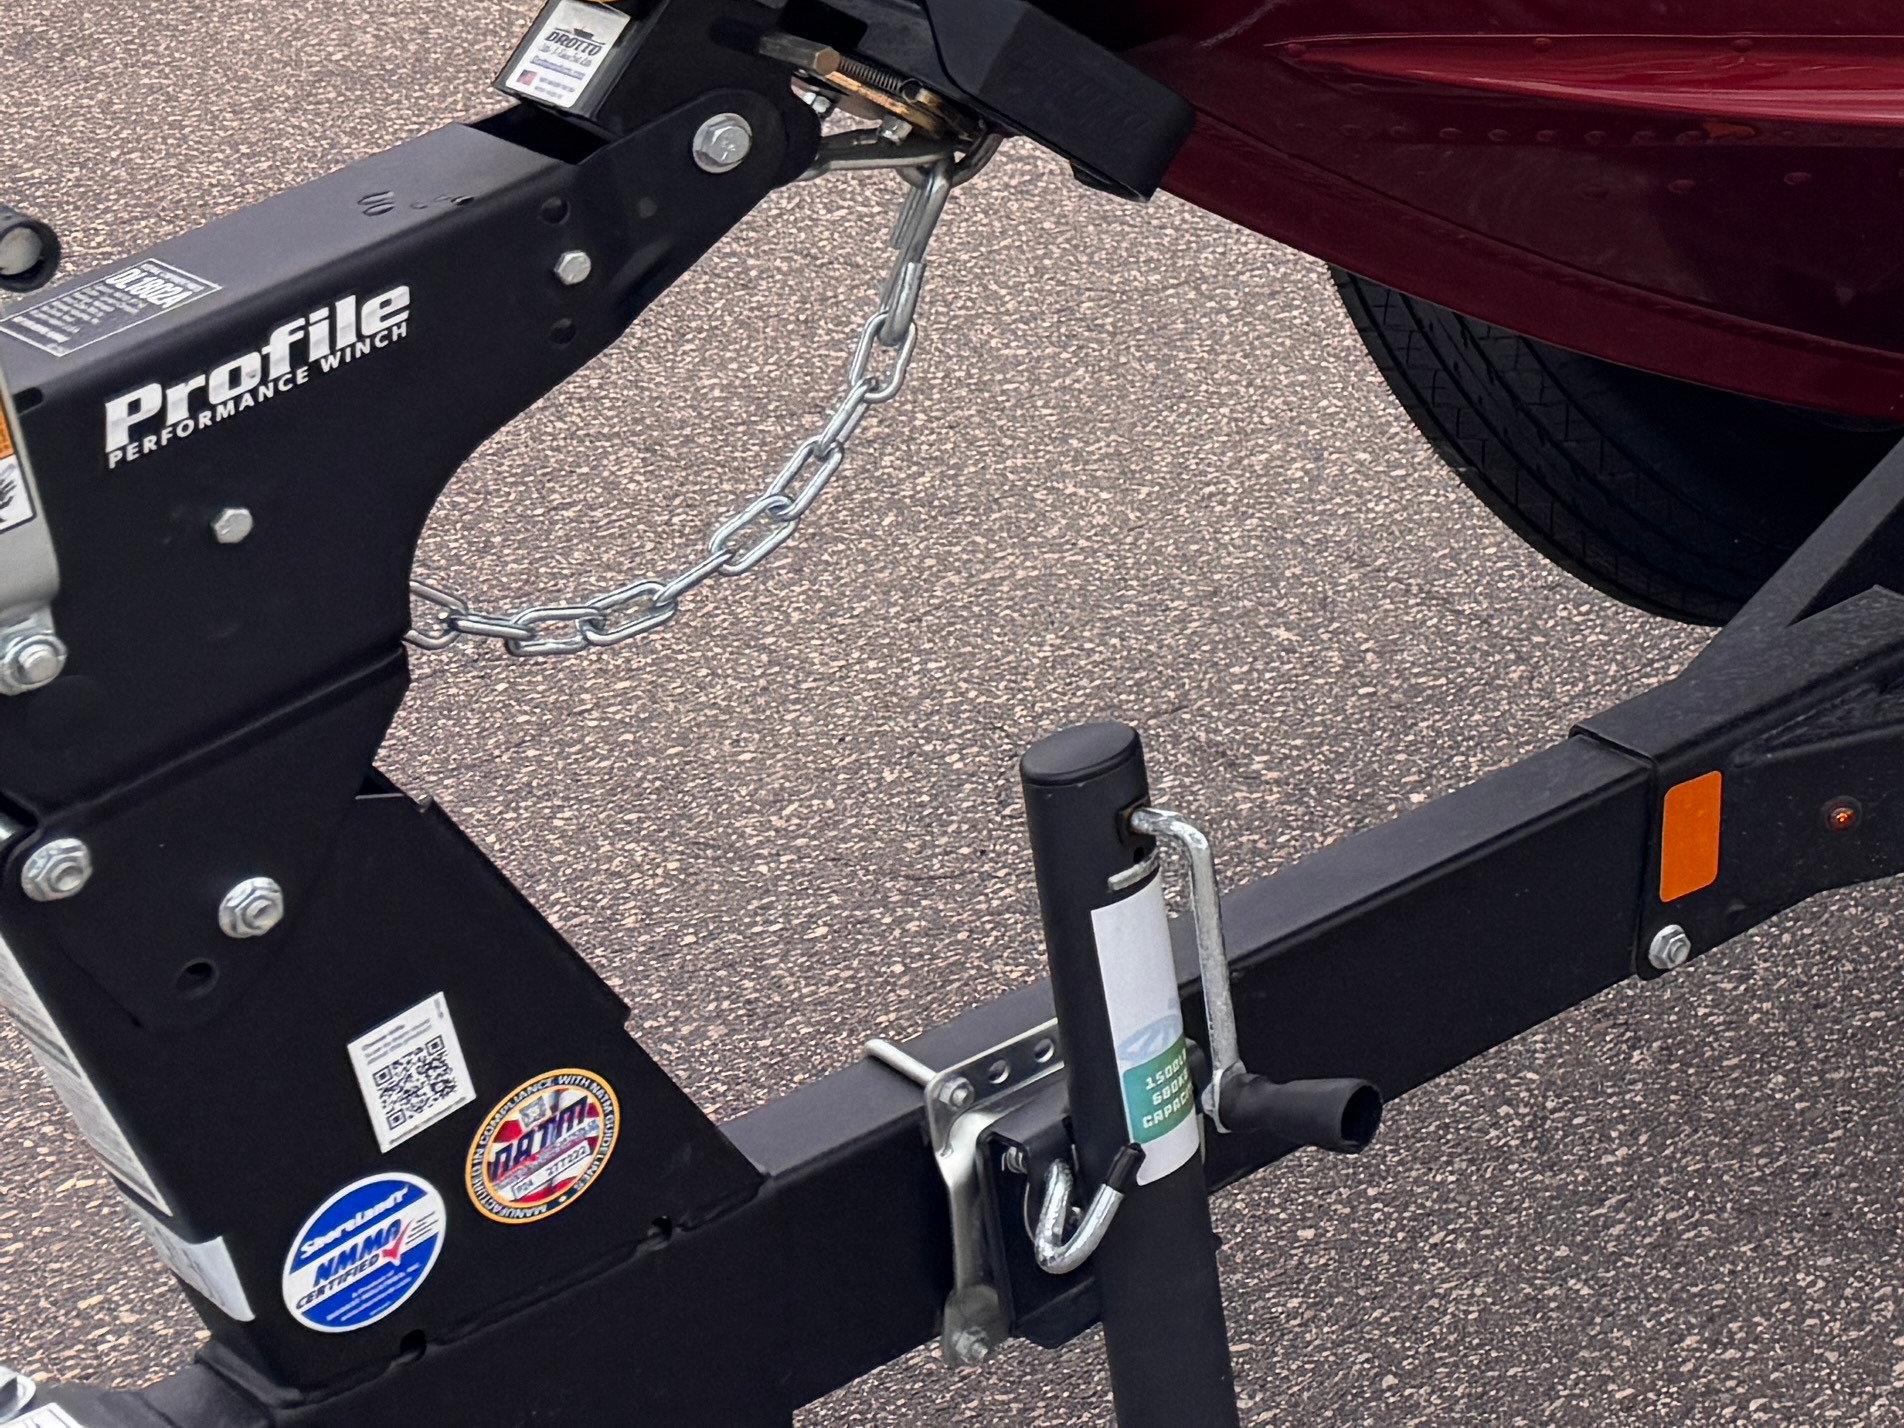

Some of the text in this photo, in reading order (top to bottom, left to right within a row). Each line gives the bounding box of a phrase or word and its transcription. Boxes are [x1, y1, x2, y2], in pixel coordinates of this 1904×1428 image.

[544, 31, 603, 56] DROTTO
[105, 285, 410, 453] Profile
[108, 322, 407, 470] PERFORMANCE WINCH
[558, 1075, 590, 1087] WITH
[296, 1253, 380, 1309] CERTIFIED
[313, 1218, 402, 1288] NMMA
